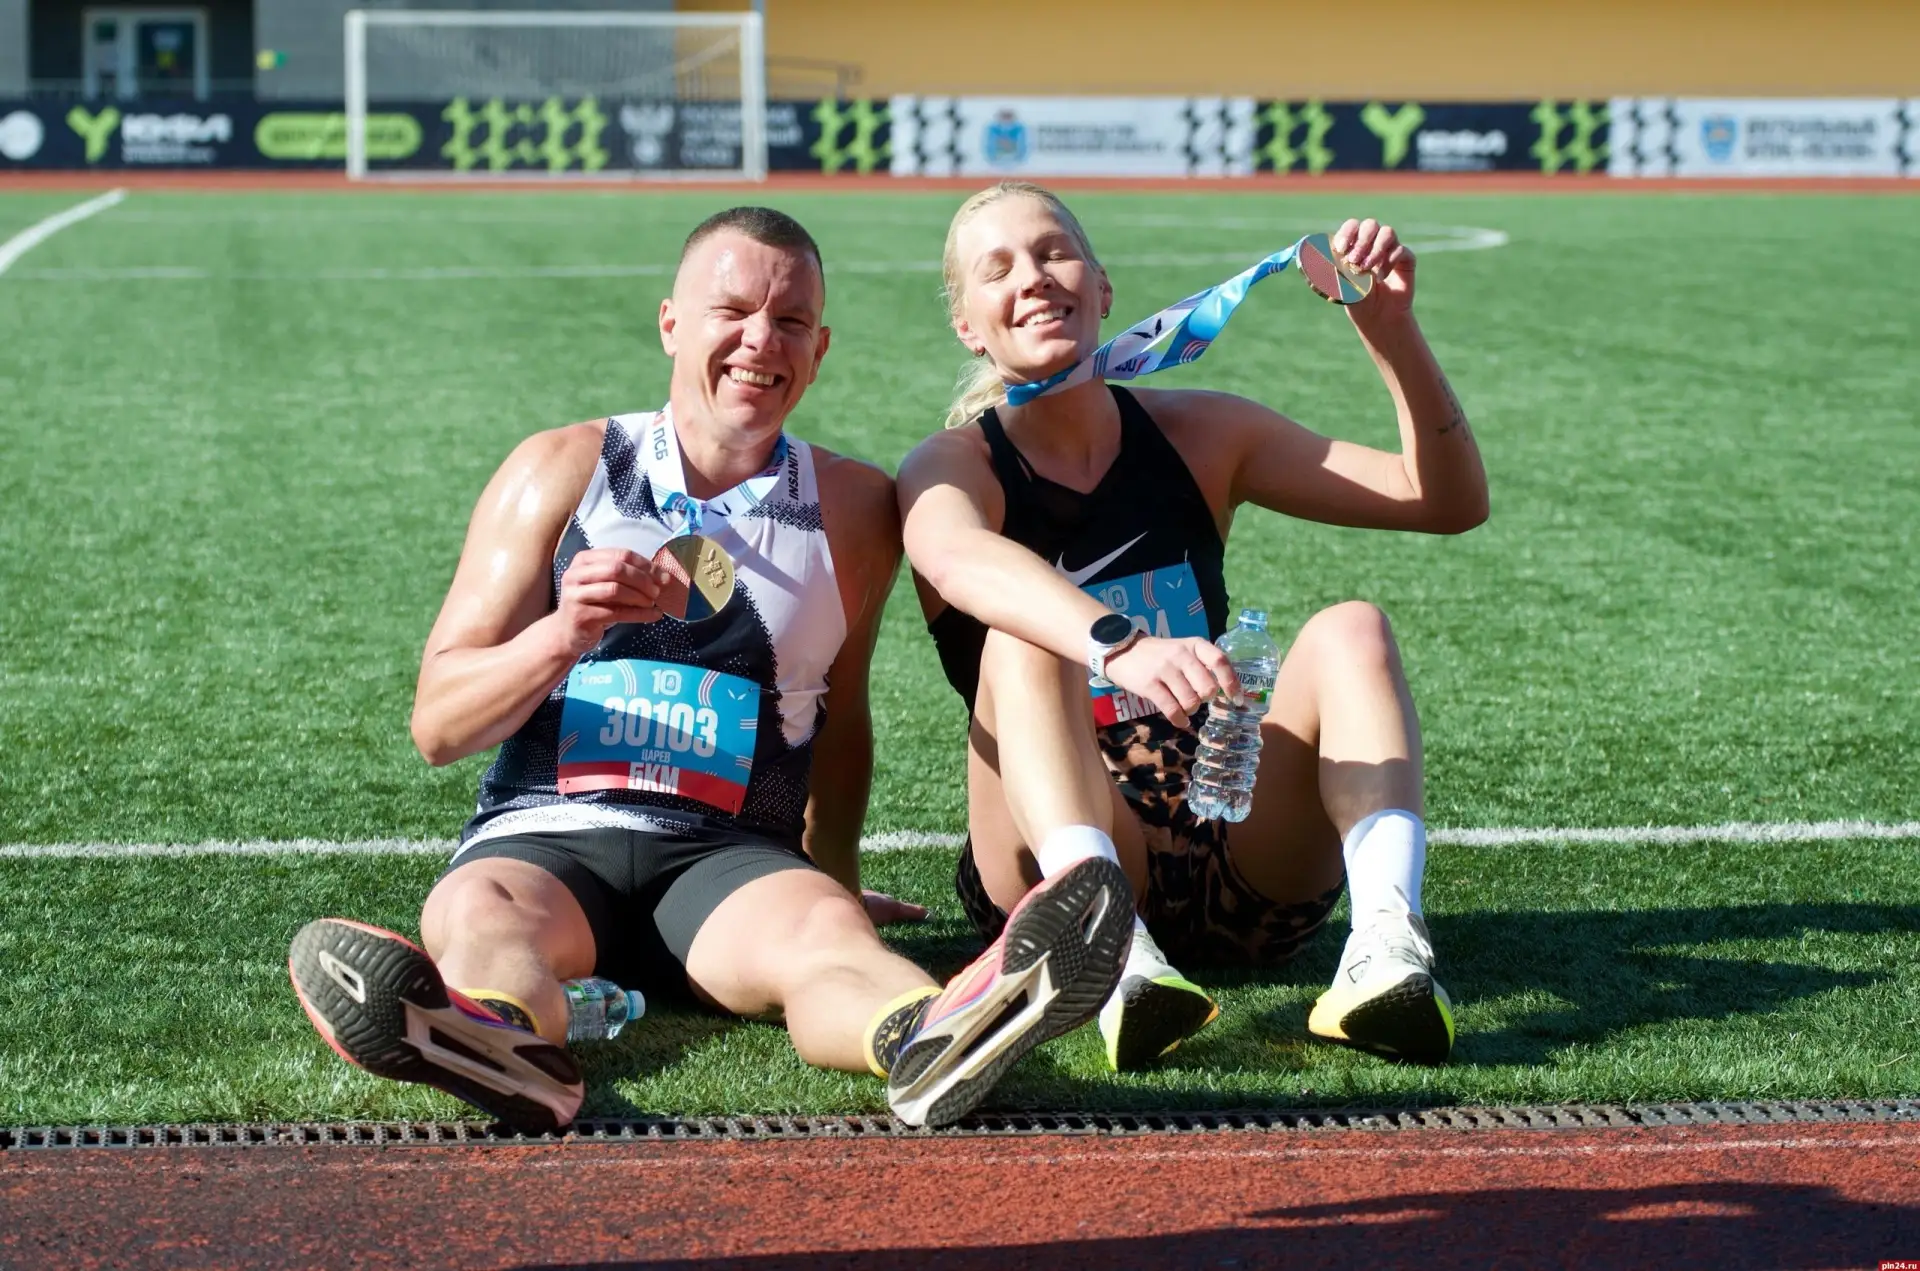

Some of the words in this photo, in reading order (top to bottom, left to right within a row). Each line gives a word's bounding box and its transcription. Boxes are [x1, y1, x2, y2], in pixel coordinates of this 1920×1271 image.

[653, 426, 668, 461] ПСБ
[787, 443, 799, 501] INSANITY
[651, 669, 682, 696] 10
[600, 696, 719, 758] 30103
[641, 748, 671, 764] ЦАРЕВ
[627, 761, 680, 795] 5КМ
